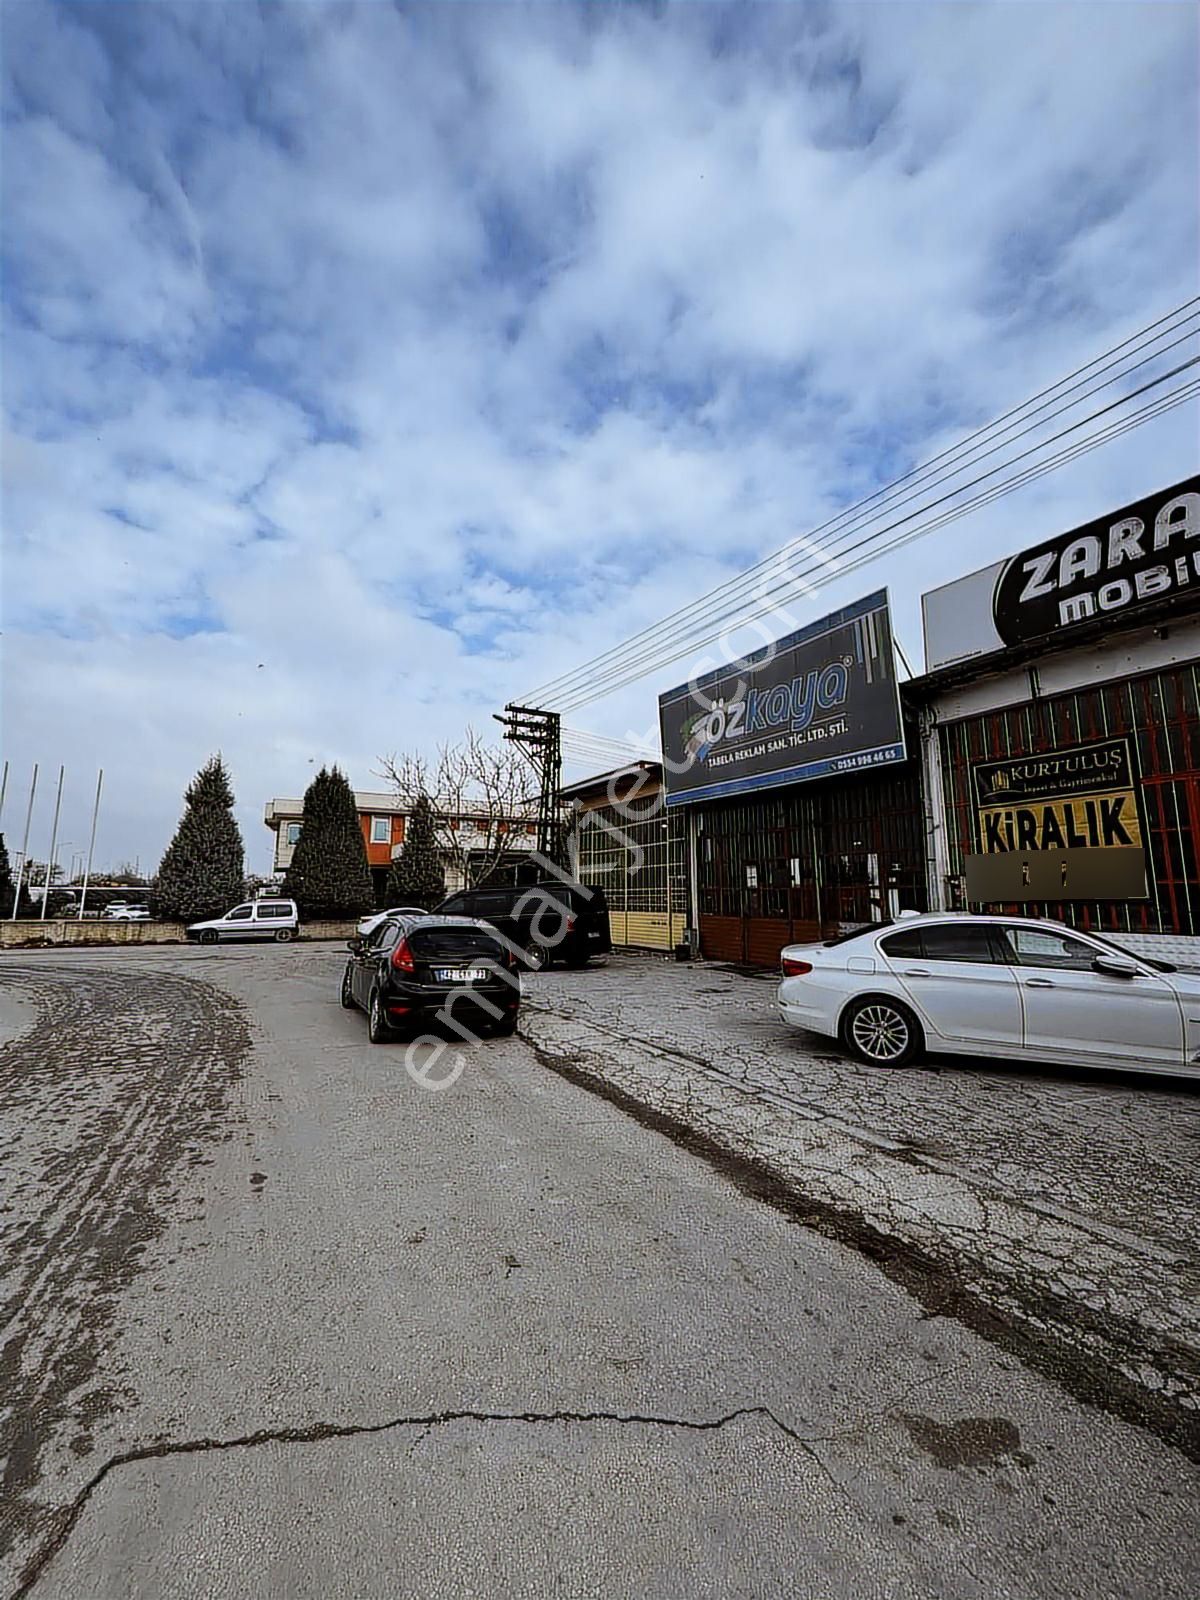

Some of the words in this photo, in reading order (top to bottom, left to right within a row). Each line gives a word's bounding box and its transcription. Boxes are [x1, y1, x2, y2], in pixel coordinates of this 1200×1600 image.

[1019, 492, 1200, 603] ZARA
[708, 752, 735, 768] TABELA
[735, 744, 766, 761] REKLAM
[807, 727, 828, 742] LTD.
[1011, 748, 1122, 781] KURTULUŞ
